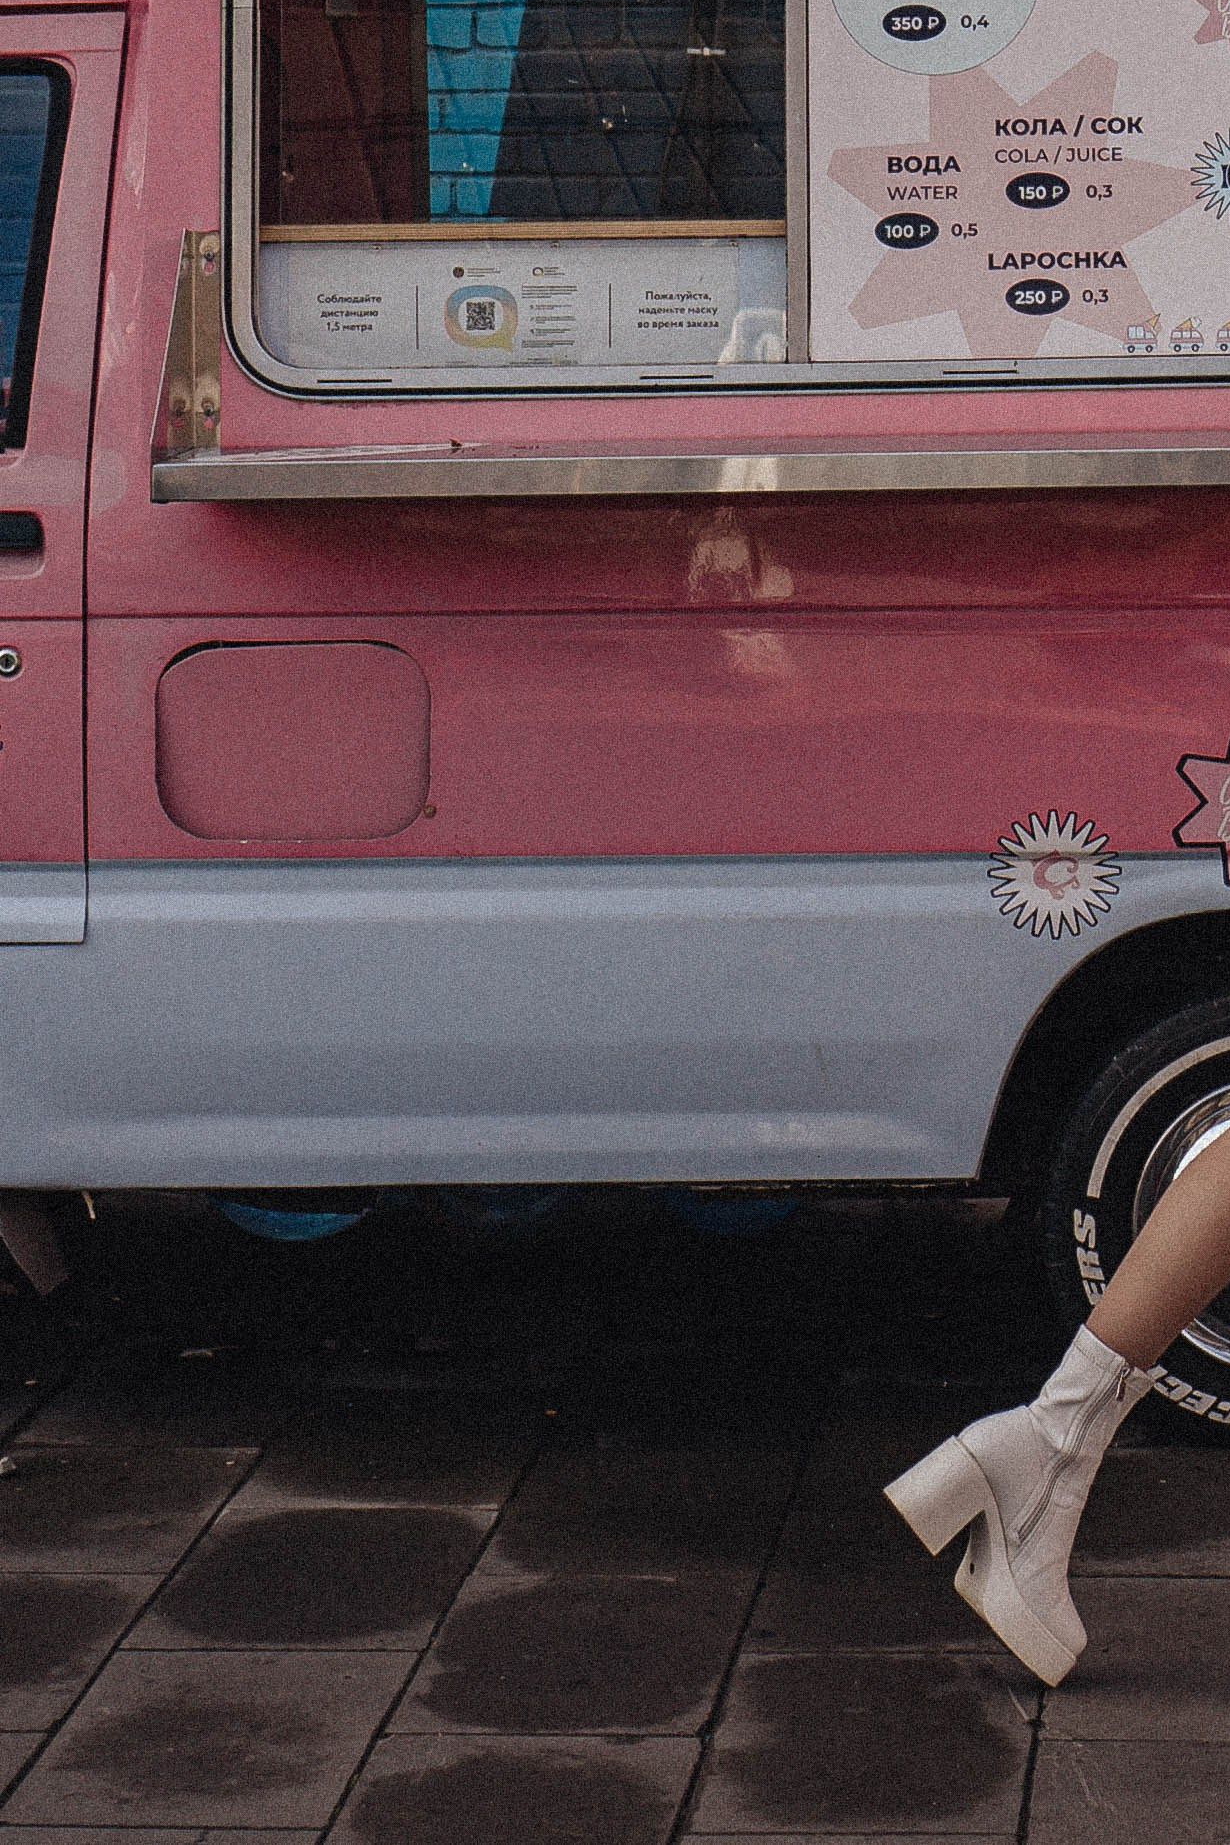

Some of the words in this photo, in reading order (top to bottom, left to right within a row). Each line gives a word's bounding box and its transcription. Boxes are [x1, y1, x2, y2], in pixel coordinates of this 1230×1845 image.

[960, 14, 990, 32] 0,4
[994, 118, 1068, 136] КОЛА
[1073, 114, 1085, 138] /
[1091, 116, 1144, 135] СОК
[994, 148, 1049, 164] COLA
[1066, 146, 1123, 162] JUICE
[887, 155, 962, 176] ВОДА
[886, 185, 959, 201] WATER
[1085, 184, 1113, 201] 0,3
[950, 222, 979, 240] 0,5
[987, 251, 1128, 270] LAPOCHKA
[316, 292, 382, 304] Соблюдайте
[645, 290, 712, 303] Пожалуйста,
[1082, 288, 1109, 306] 0,3
[320, 309, 379, 319] дистанцию
[687, 307, 719, 316] маску
[326, 321, 341, 332] 1,5
[342, 323, 373, 333] метра
[652, 320, 684, 330] время
[686, 320, 720, 329] заказа
